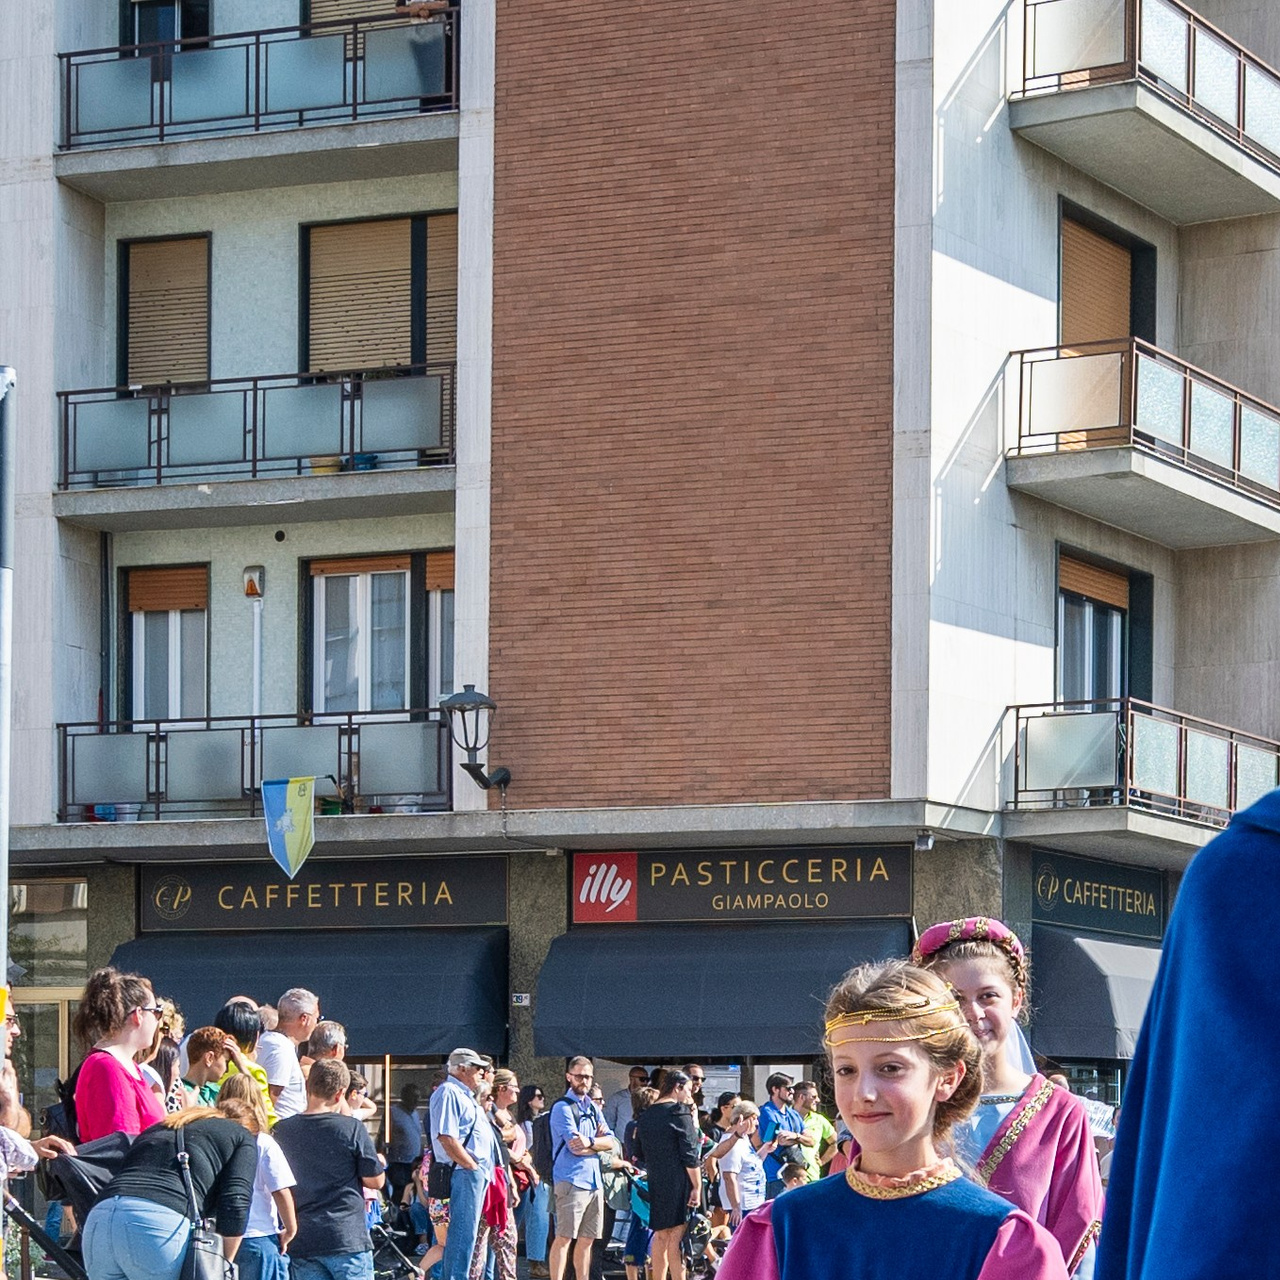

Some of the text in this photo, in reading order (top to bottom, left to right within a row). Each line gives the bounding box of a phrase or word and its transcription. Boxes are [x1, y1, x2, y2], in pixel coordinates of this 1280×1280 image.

[651, 857, 889, 886] PASTICCERIA
[218, 881, 453, 910] CAFFETTERIA
[579, 863, 632, 912] illy
[712, 892, 828, 910] GIAMPAOLO
[1063, 878, 1156, 916] CAFFETTERIA
